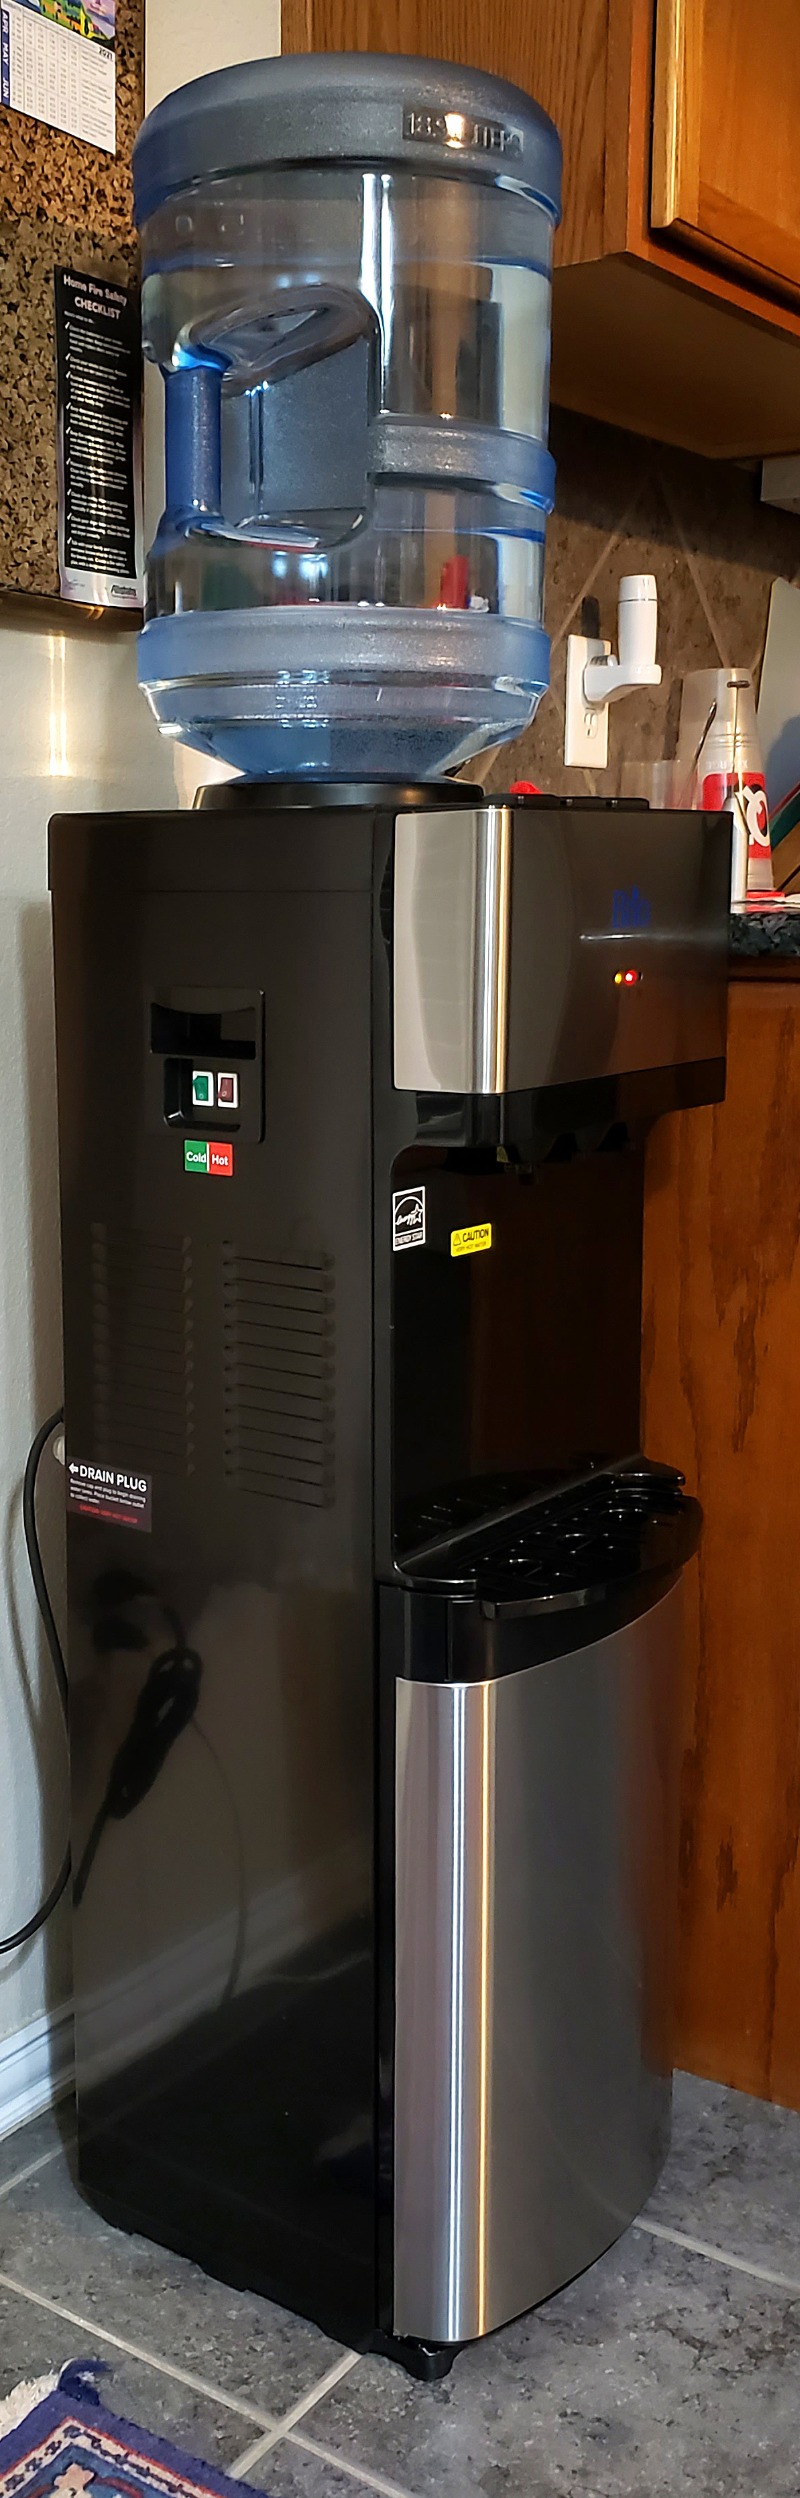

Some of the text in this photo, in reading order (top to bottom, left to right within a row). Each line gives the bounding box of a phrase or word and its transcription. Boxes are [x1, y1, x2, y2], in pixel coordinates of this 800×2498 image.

[99, 47, 113, 62] 2021
[63, 274, 127, 307] Home Fire Safety
[74, 296, 121, 320] CHECKLIST
[186, 1151, 229, 1166] Cold Hot
[462, 1228, 489, 1242] CAUTION
[79, 1465, 147, 1492] DRAIN PLUG
